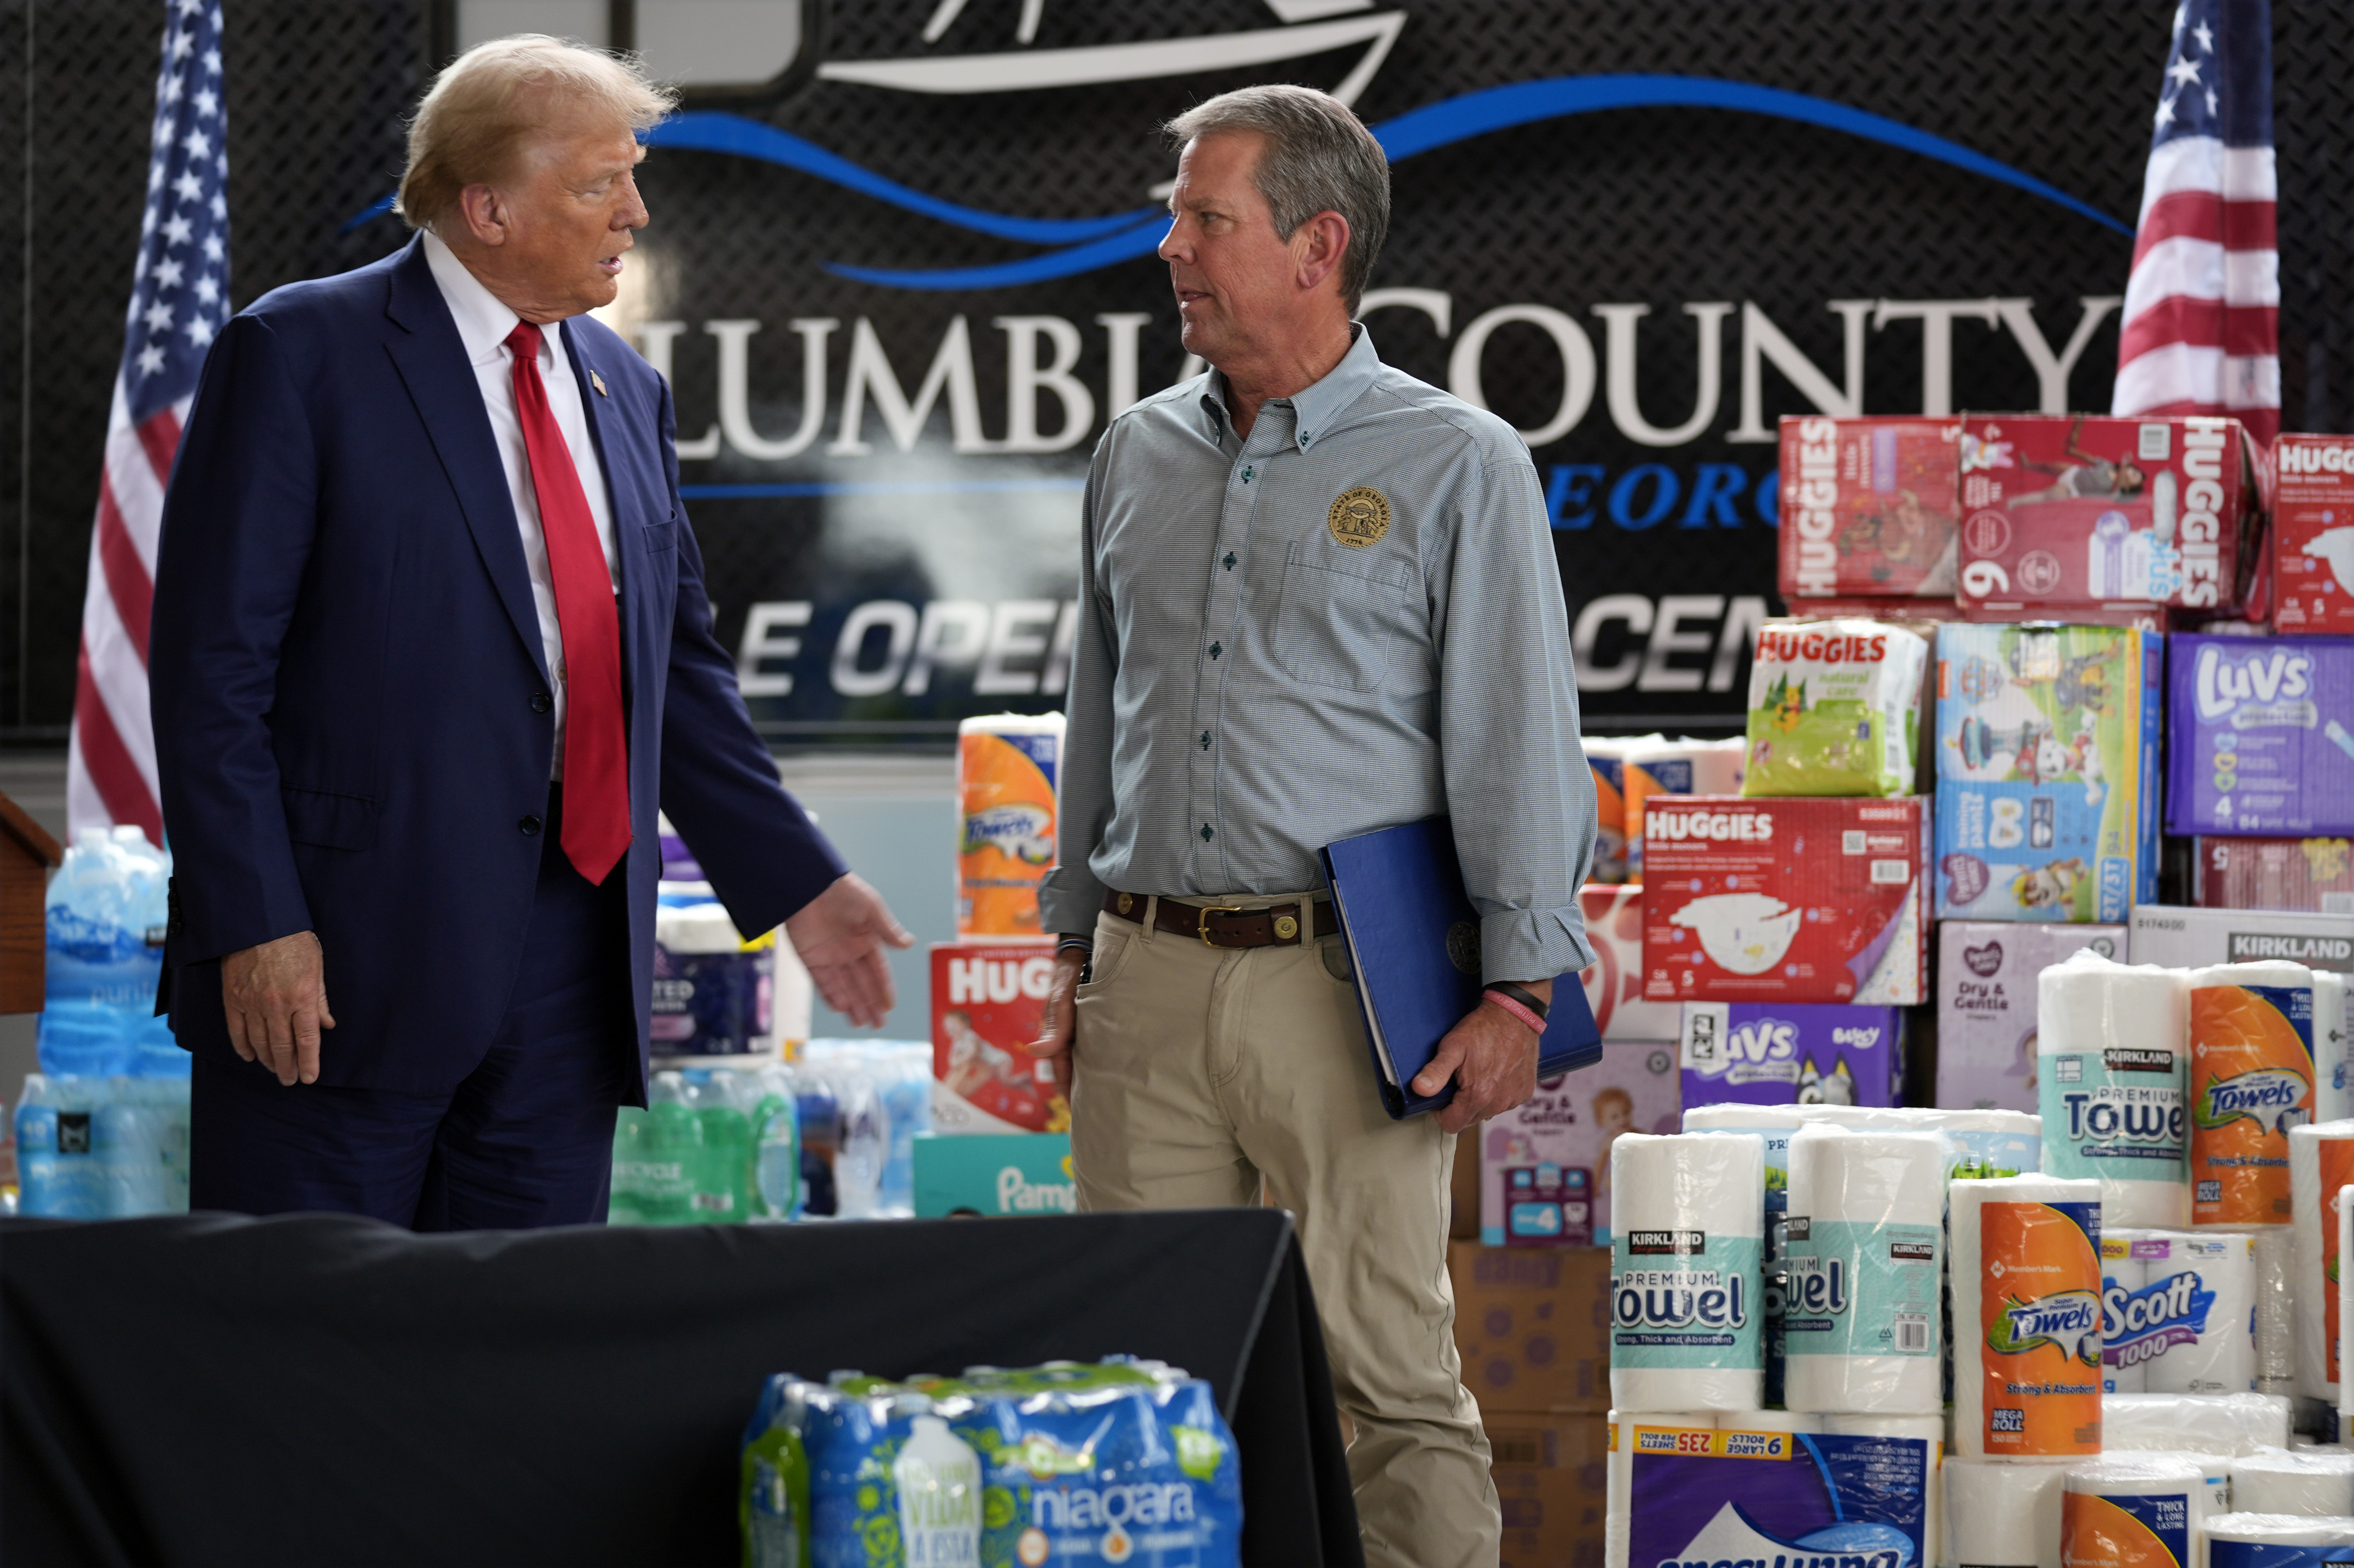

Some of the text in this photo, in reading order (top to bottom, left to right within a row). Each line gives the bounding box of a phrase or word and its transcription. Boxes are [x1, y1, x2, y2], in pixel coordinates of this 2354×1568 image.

[637, 313, 1208, 459] LUMBI
[1332, 496, 1350, 520] STATE
[1366, 492, 1387, 527] GEORGIA
[1797, 418, 1838, 595] HUGGIES
[2181, 417, 2225, 607] HUGGIES
[1962, 560, 2009, 598] 6
[1756, 631, 1886, 663] HUGGIES
[1819, 671, 1870, 683] natural
[1827, 685, 1858, 696] care
[2216, 795, 2232, 816] 4
[1646, 811, 1773, 840] HUGGIES
[2234, 935, 2351, 958] KIRKLAND
[1682, 972, 1694, 986] 5
[1959, 983, 2004, 996] Dry &
[1955, 996, 2008, 1010] Gentle
[2107, 1051, 2172, 1064] KIRKLAND
[2209, 1080, 2296, 1119] Towels
[1519, 1109, 1576, 1124] Gentle
[2207, 1156, 2291, 1167] Strong & Absorbe
[2198, 1182, 2221, 1190] MEGA
[2197, 1191, 2221, 1201] ROLL
[1632, 1233, 1702, 1245] KIRKLAND
[1893, 1244, 1933, 1255] KIRKLAND
[1626, 1274, 1714, 1285] PREMIUM
[2103, 1272, 2197, 1340] Scott
[2007, 1302, 2093, 1343] Towels
[1617, 1335, 1638, 1343] Strong,
[2117, 1333, 2168, 1368] 1000
[2007, 1384, 2041, 1396] Strong
[2043, 1384, 2051, 1393] &
[2054, 1384, 2095, 1393] Absorbent
[1993, 1410, 2023, 1419] MEGA
[1993, 1419, 2023, 1430] ROLL
[1640, 1441, 1676, 1450] SHEETS
[1678, 1432, 1711, 1453] 235
[1726, 1444, 1765, 1455] LARGE
[1767, 1437, 1782, 1456] 9
[1033, 1483, 1194, 1538] niagara
[2157, 1501, 2184, 1512] THICK
[2157, 1521, 2184, 1530] LASTING
